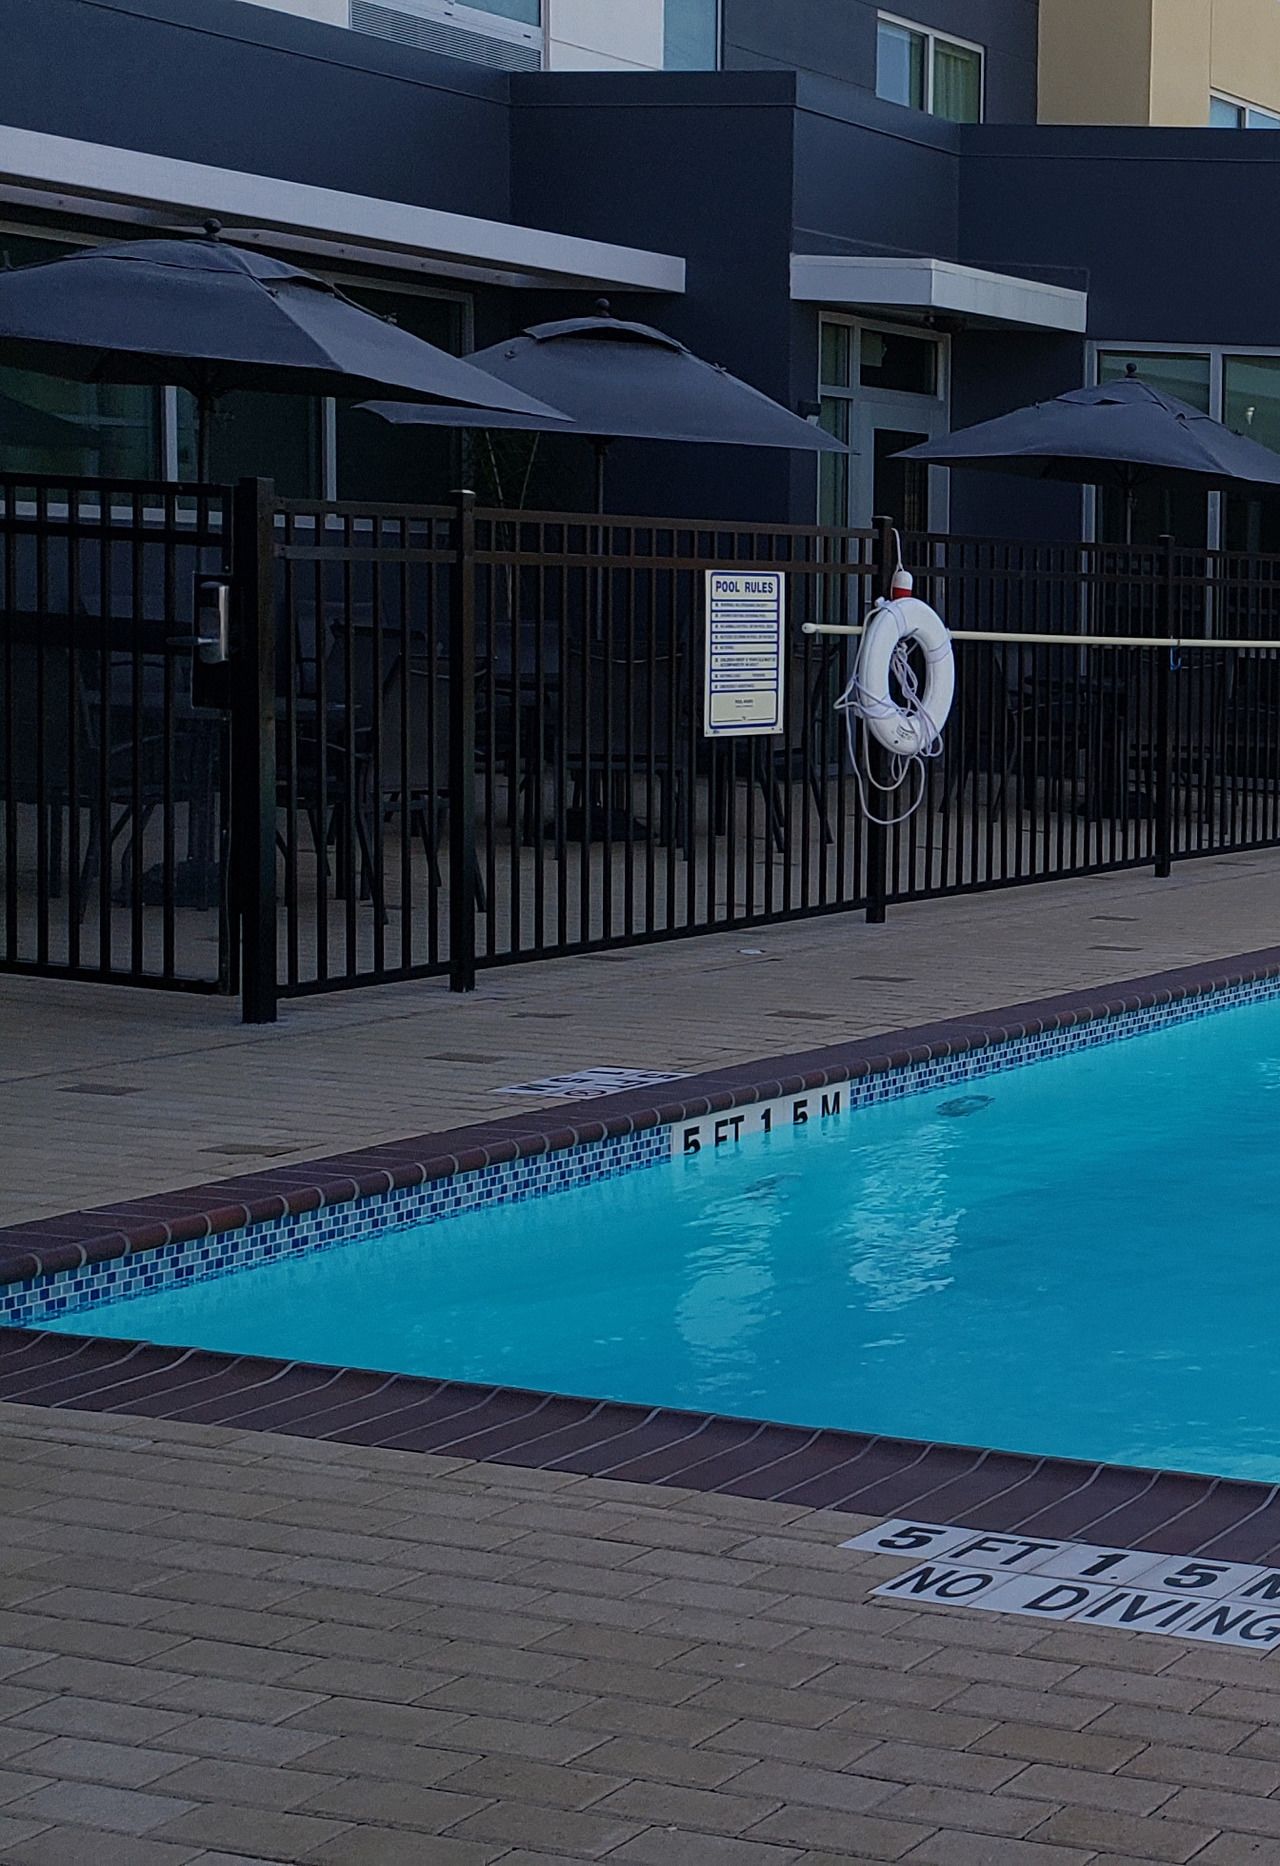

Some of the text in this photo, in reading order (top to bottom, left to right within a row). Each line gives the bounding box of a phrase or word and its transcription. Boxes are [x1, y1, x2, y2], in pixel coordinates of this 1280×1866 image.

[715, 581, 774, 594] POOL RULES
[683, 1091, 840, 1156] 5 FT 1 5 M
[878, 1526, 947, 1549] 5
[949, 1536, 1060, 1565] FT
[1163, 1563, 1232, 1588] 5
[886, 1566, 993, 1598] NO
